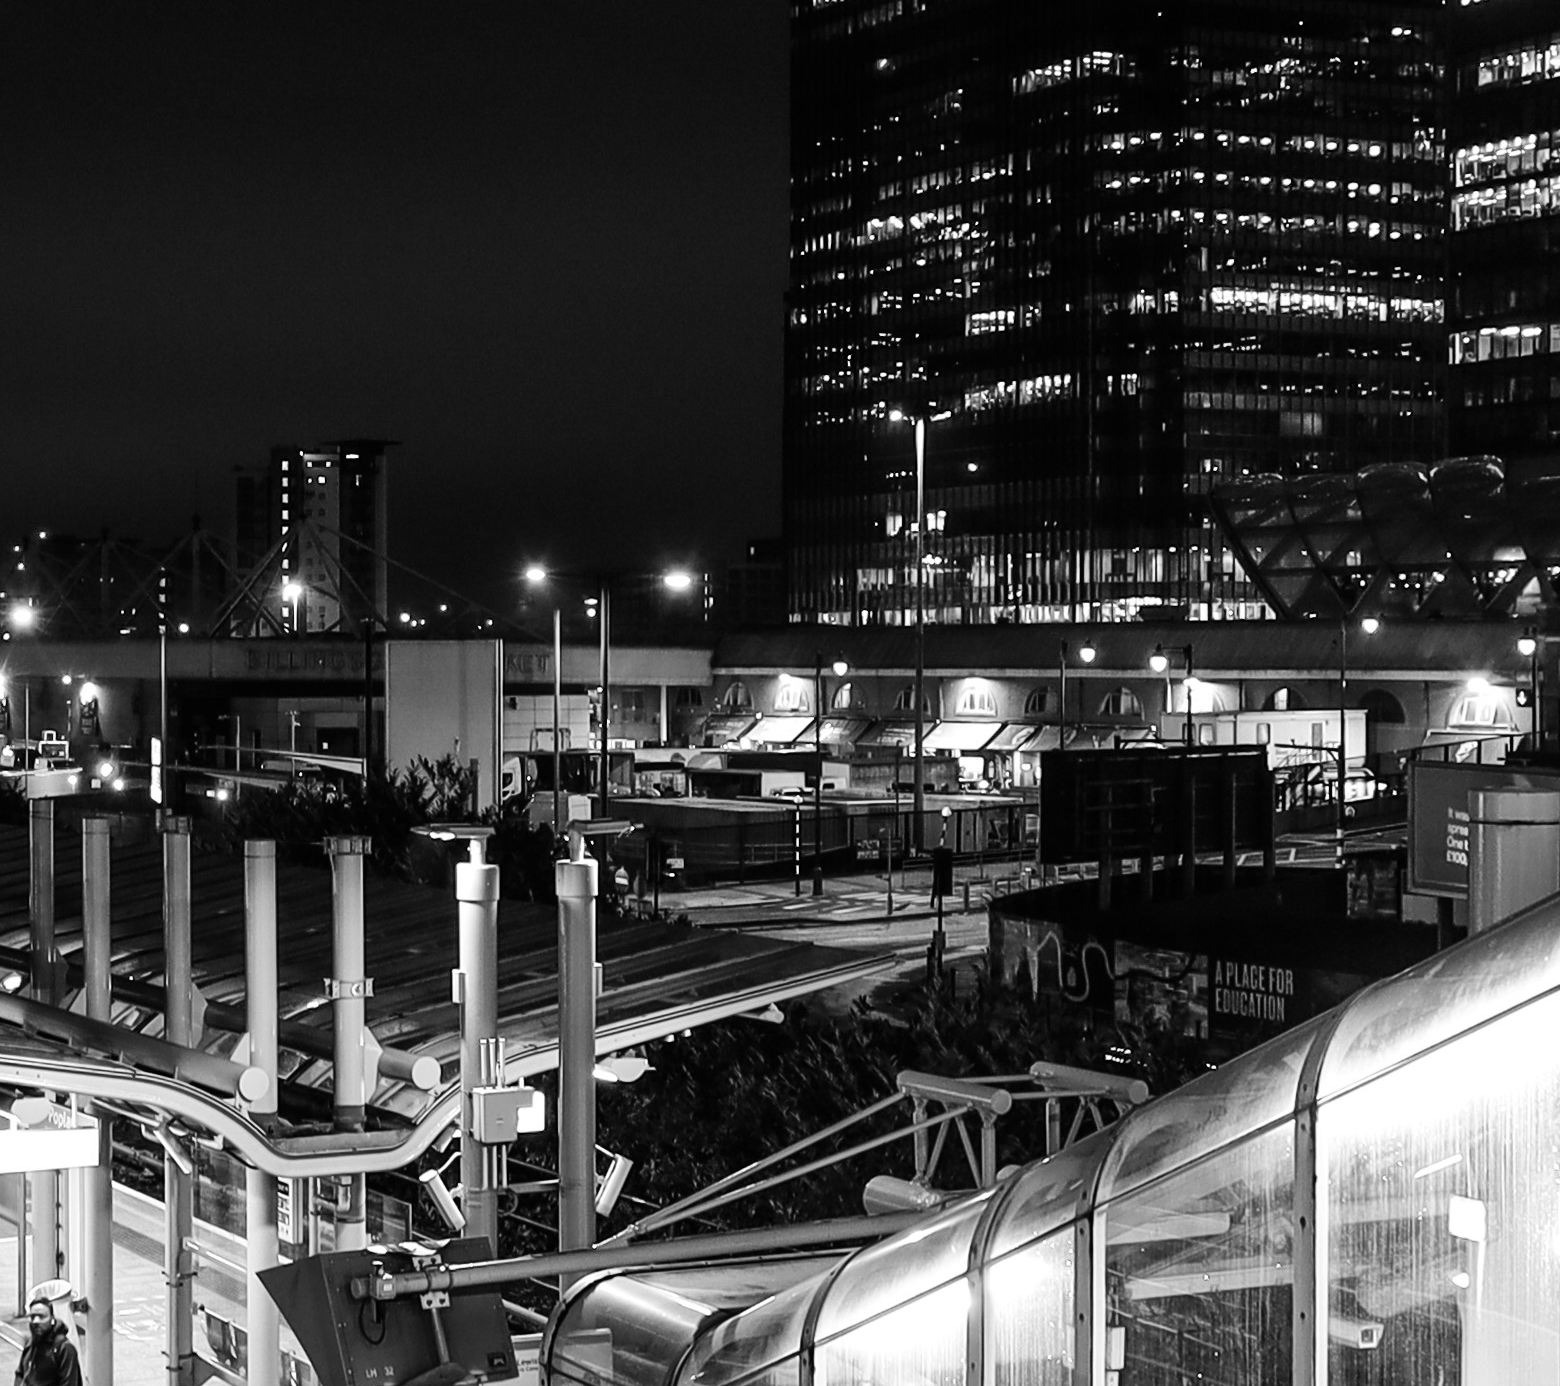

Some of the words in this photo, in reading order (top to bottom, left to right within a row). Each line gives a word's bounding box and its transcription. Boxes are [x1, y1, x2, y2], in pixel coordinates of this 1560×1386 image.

[1215, 959, 1223, 985] A
[1226, 961, 1266, 992] PLACE
[1268, 966, 1294, 995] FOR
[1215, 987, 1285, 1022] EDUCATION
[48, 1106, 71, 1129] Popla
